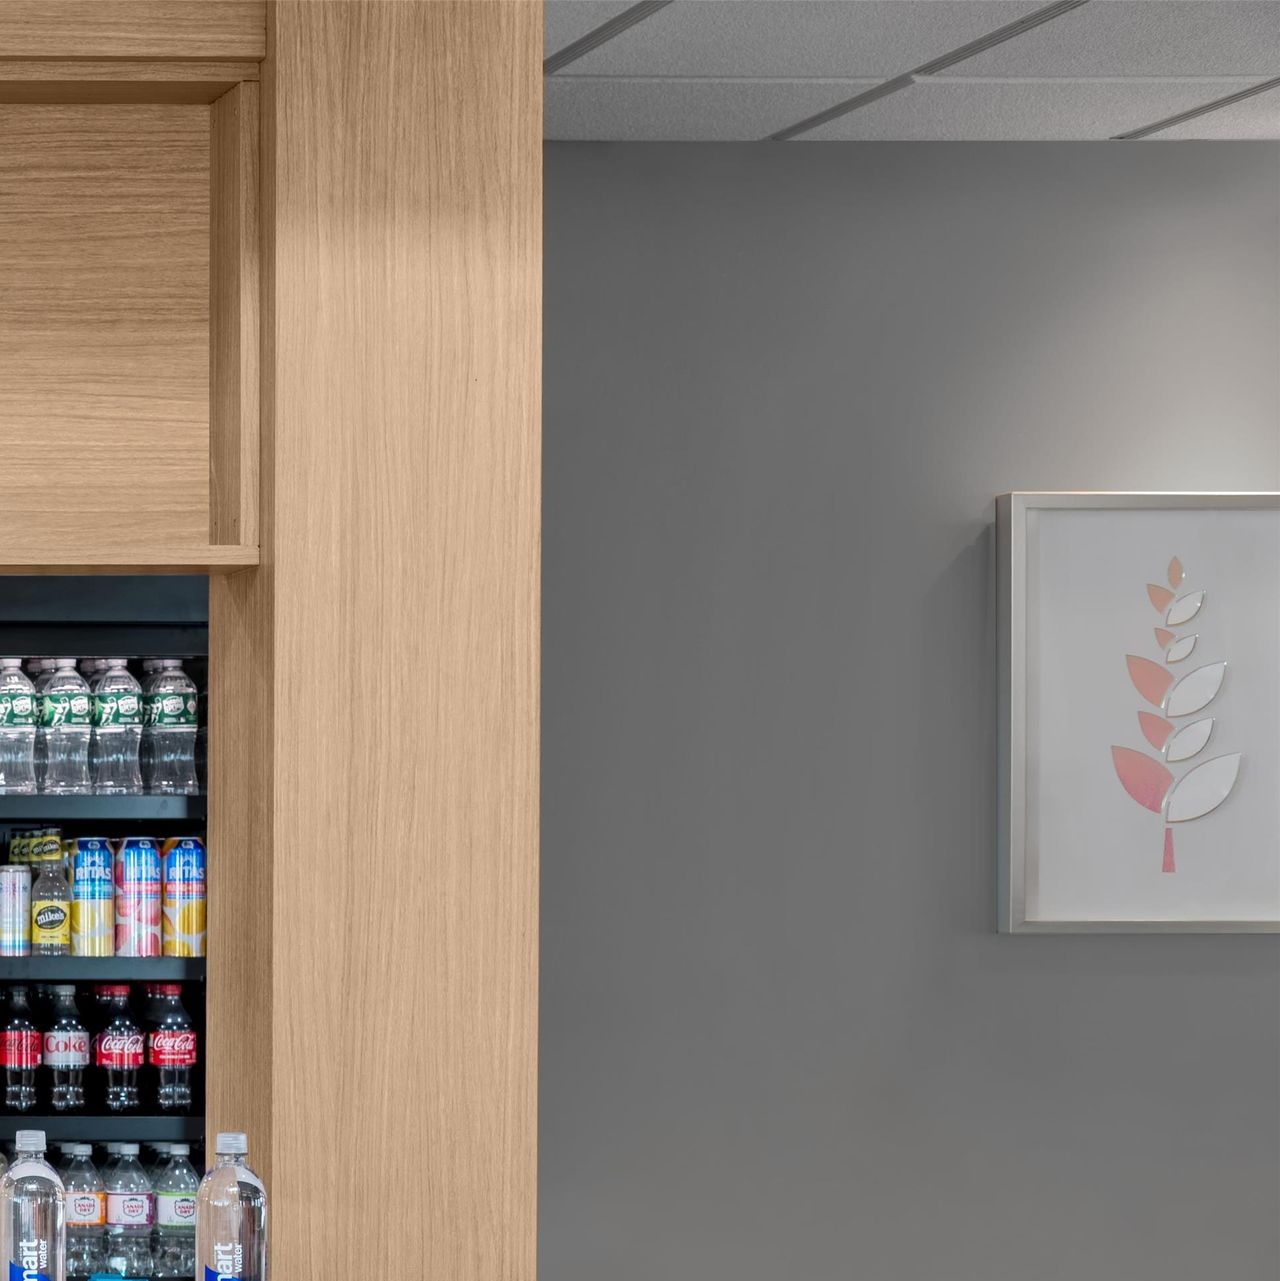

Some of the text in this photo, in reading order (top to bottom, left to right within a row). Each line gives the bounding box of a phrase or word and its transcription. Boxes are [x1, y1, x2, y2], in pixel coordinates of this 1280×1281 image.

[45, 1035, 86, 1053] Coke
[101, 1036, 143, 1054] Coca-Cola
[153, 1035, 194, 1051] Coca-Cola
[39, 1239, 48, 1269] water
[234, 1243, 243, 1273] water
